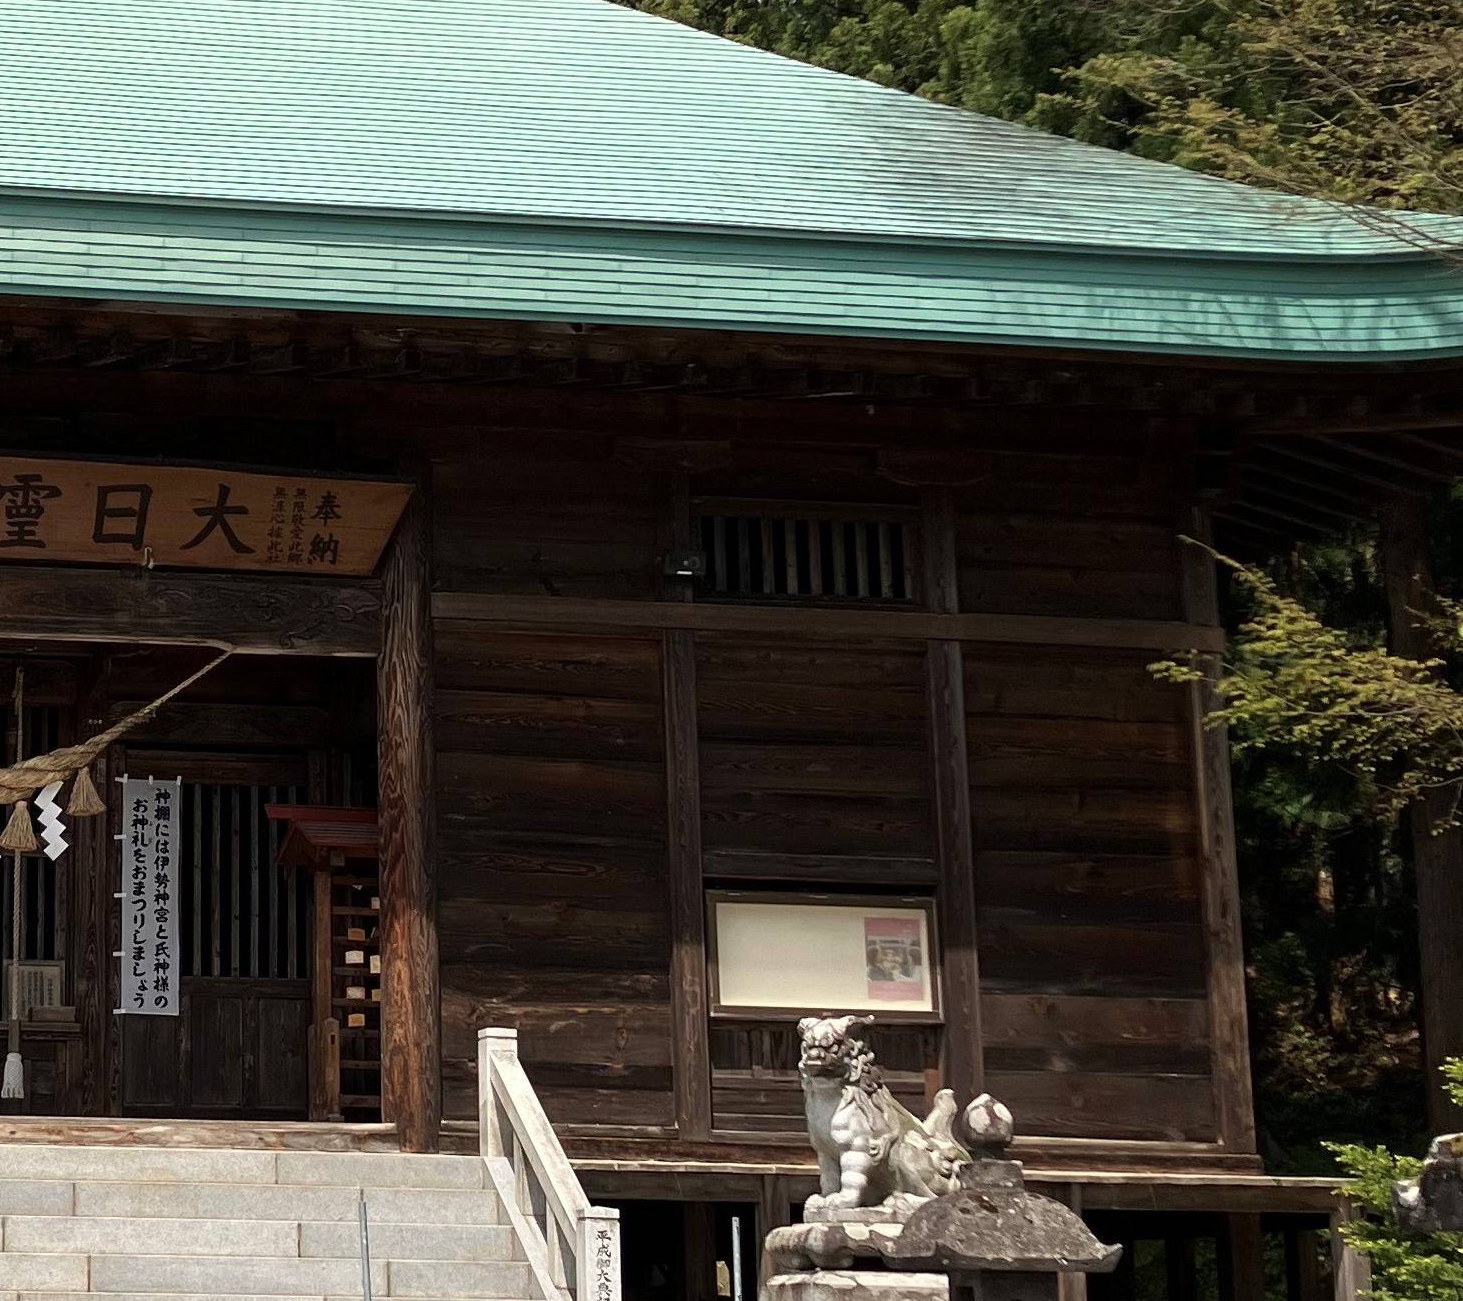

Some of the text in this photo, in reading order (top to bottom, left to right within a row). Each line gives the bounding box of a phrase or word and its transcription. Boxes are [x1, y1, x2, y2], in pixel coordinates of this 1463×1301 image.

[307, 490, 342, 565] 奉納
[153, 788, 171, 1008] 神棚には伊勢神宮と氏神様の
